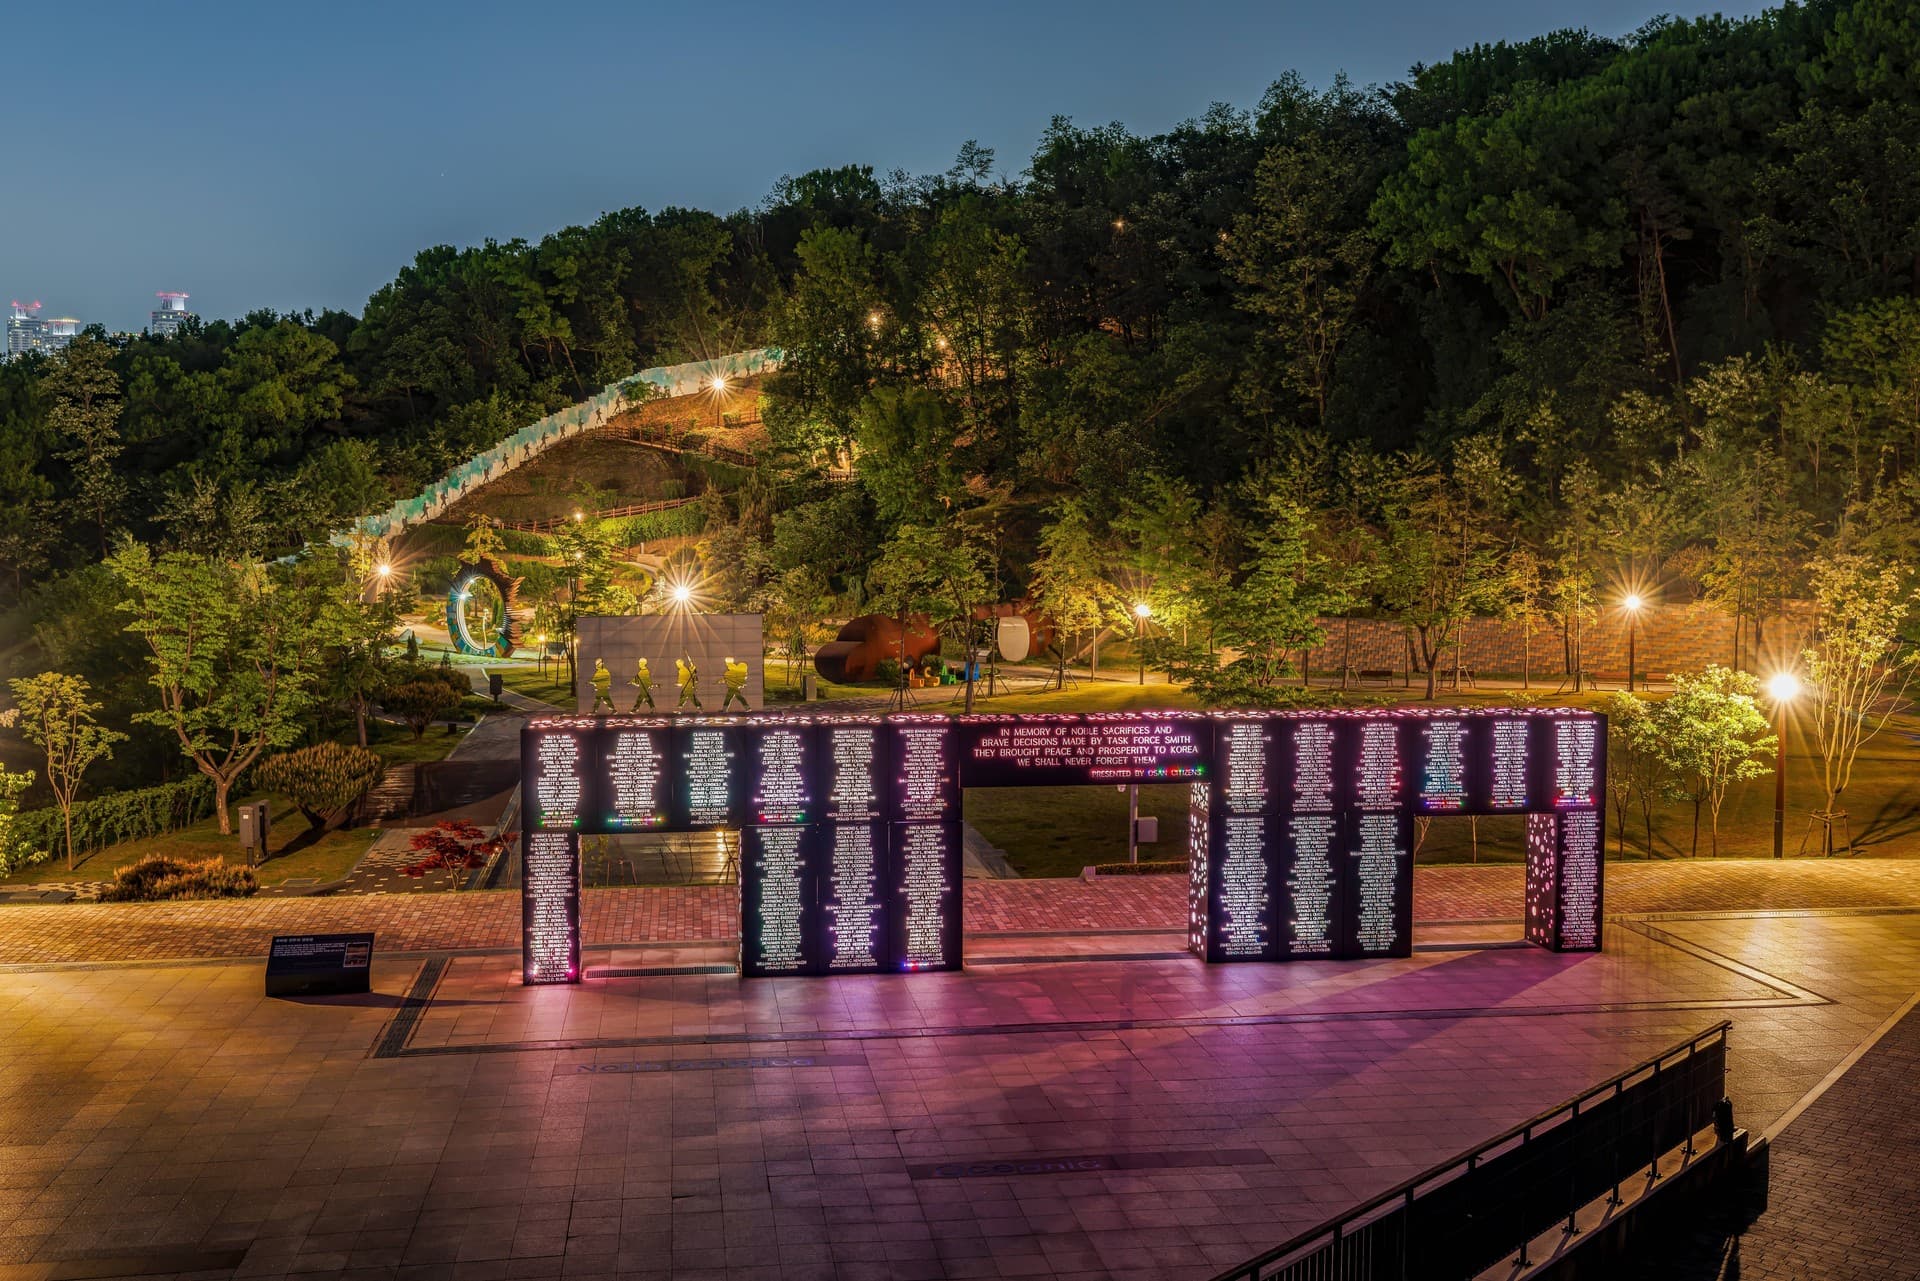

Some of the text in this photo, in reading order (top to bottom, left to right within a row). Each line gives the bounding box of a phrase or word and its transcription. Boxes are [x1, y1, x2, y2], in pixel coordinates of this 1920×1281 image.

[1001, 728, 1010, 736] IN
[1014, 728, 1051, 736] MEMORY
[1014, 738, 1058, 746] DECISIONS
[1165, 735, 1191, 744] SMITH
[974, 749, 995, 757] THEY
[1000, 748, 1040, 756] BROUGHT
[1099, 746, 1149, 754] PROSPERITY
[1171, 745, 1198, 754] KOREA
[1017, 758, 1030, 766] WE
[1065, 757, 1091, 765] NEVER
[1096, 757, 1128, 765] FORGET
[1171, 768, 1202, 776] CITIZENS
